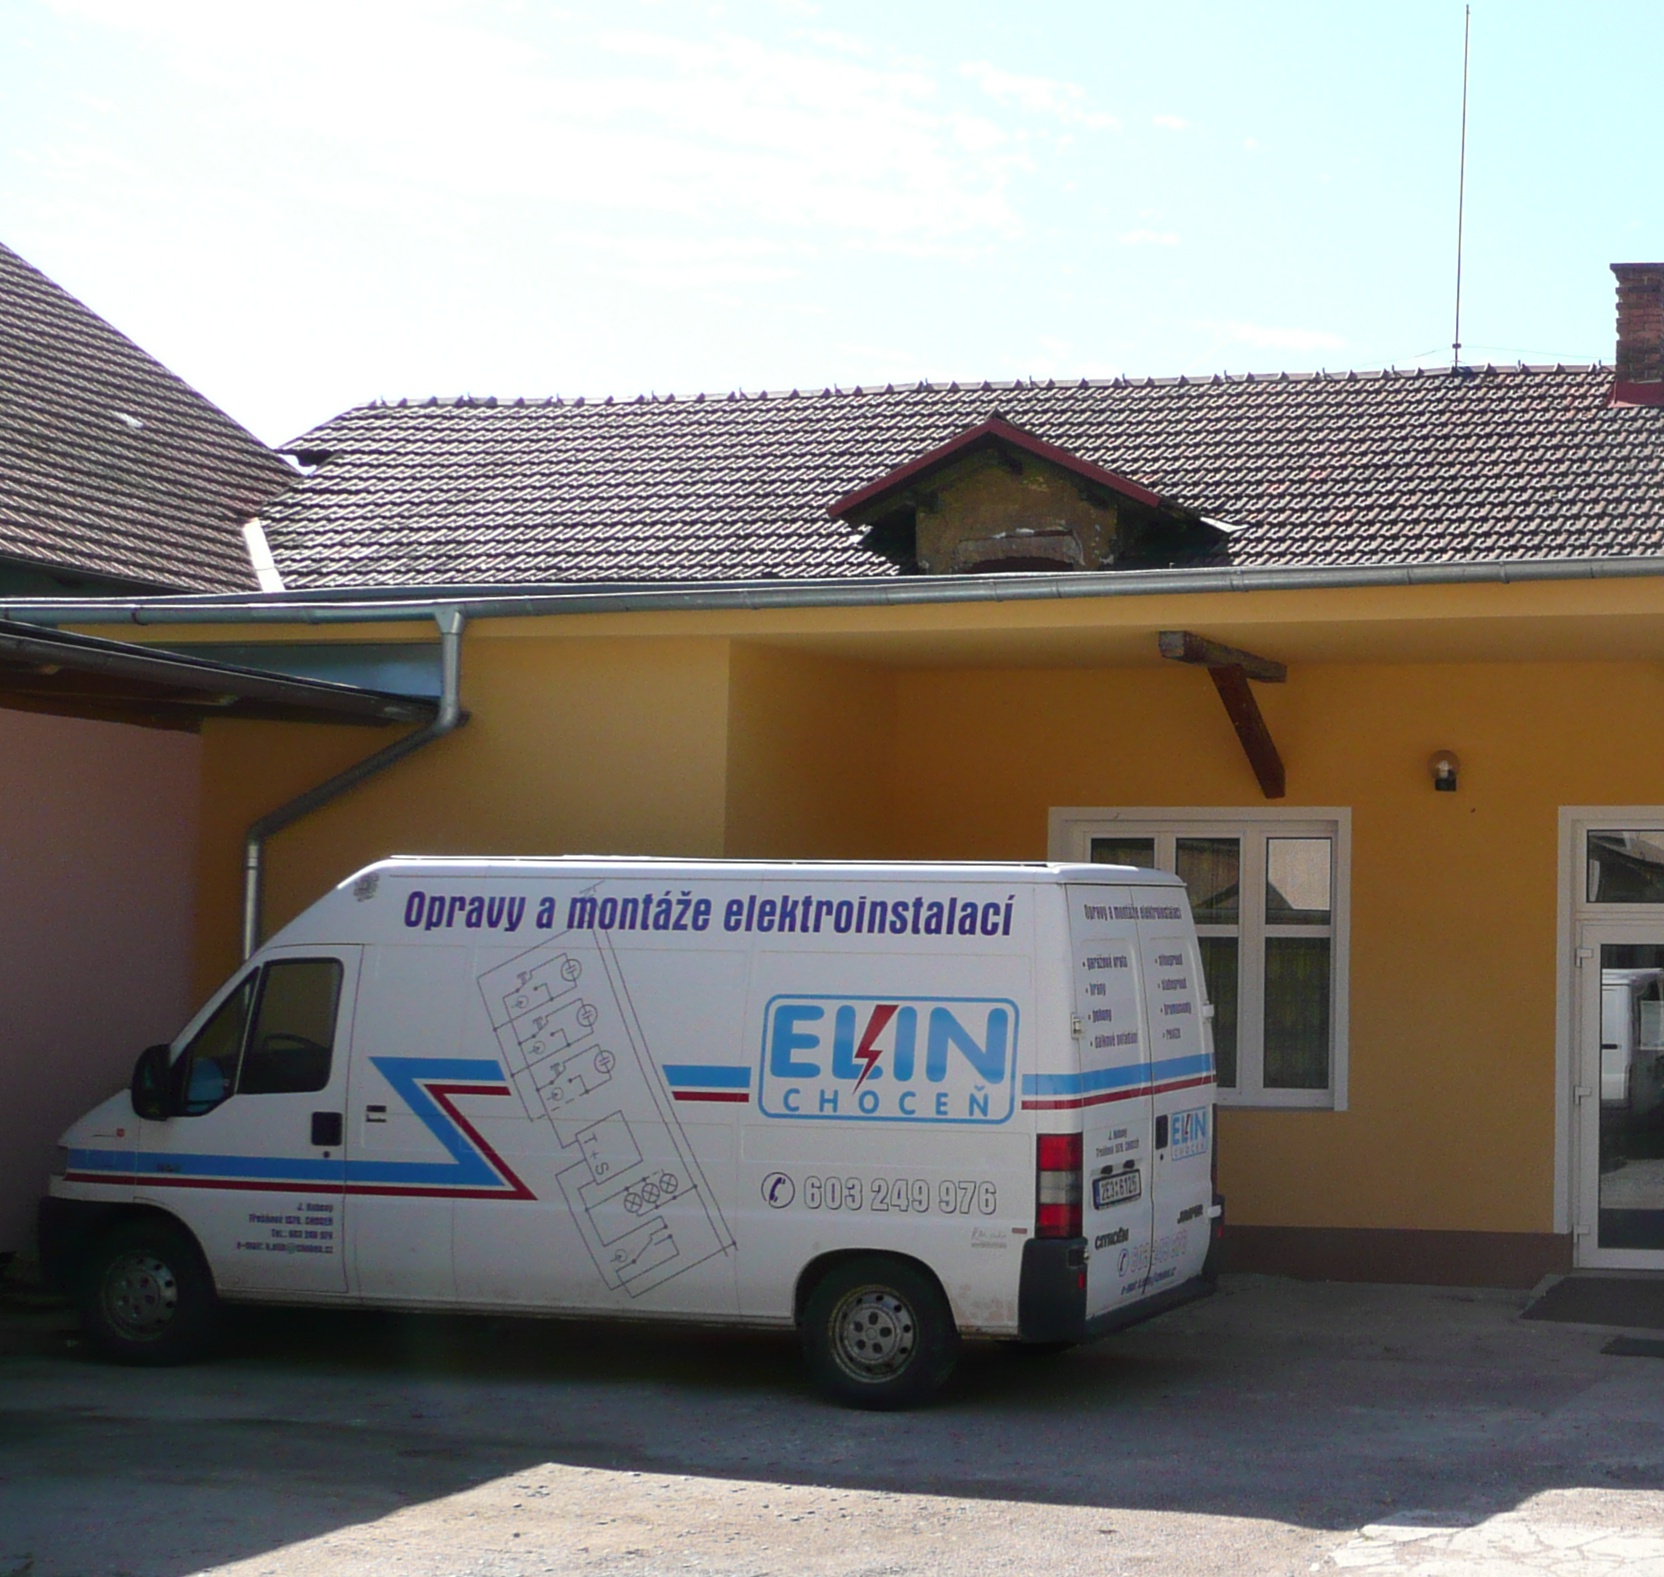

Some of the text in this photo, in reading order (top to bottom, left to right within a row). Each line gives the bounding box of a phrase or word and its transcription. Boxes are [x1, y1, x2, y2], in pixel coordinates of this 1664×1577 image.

[404, 891, 1016, 936] Opravy a montáže elektroinstalací
[770, 1004, 1008, 1084] ELIN
[783, 1085, 989, 1117] CHOCEŇ
[1172, 1111, 1206, 1146] ELIN
[803, 1176, 997, 1215] 603 249 976
